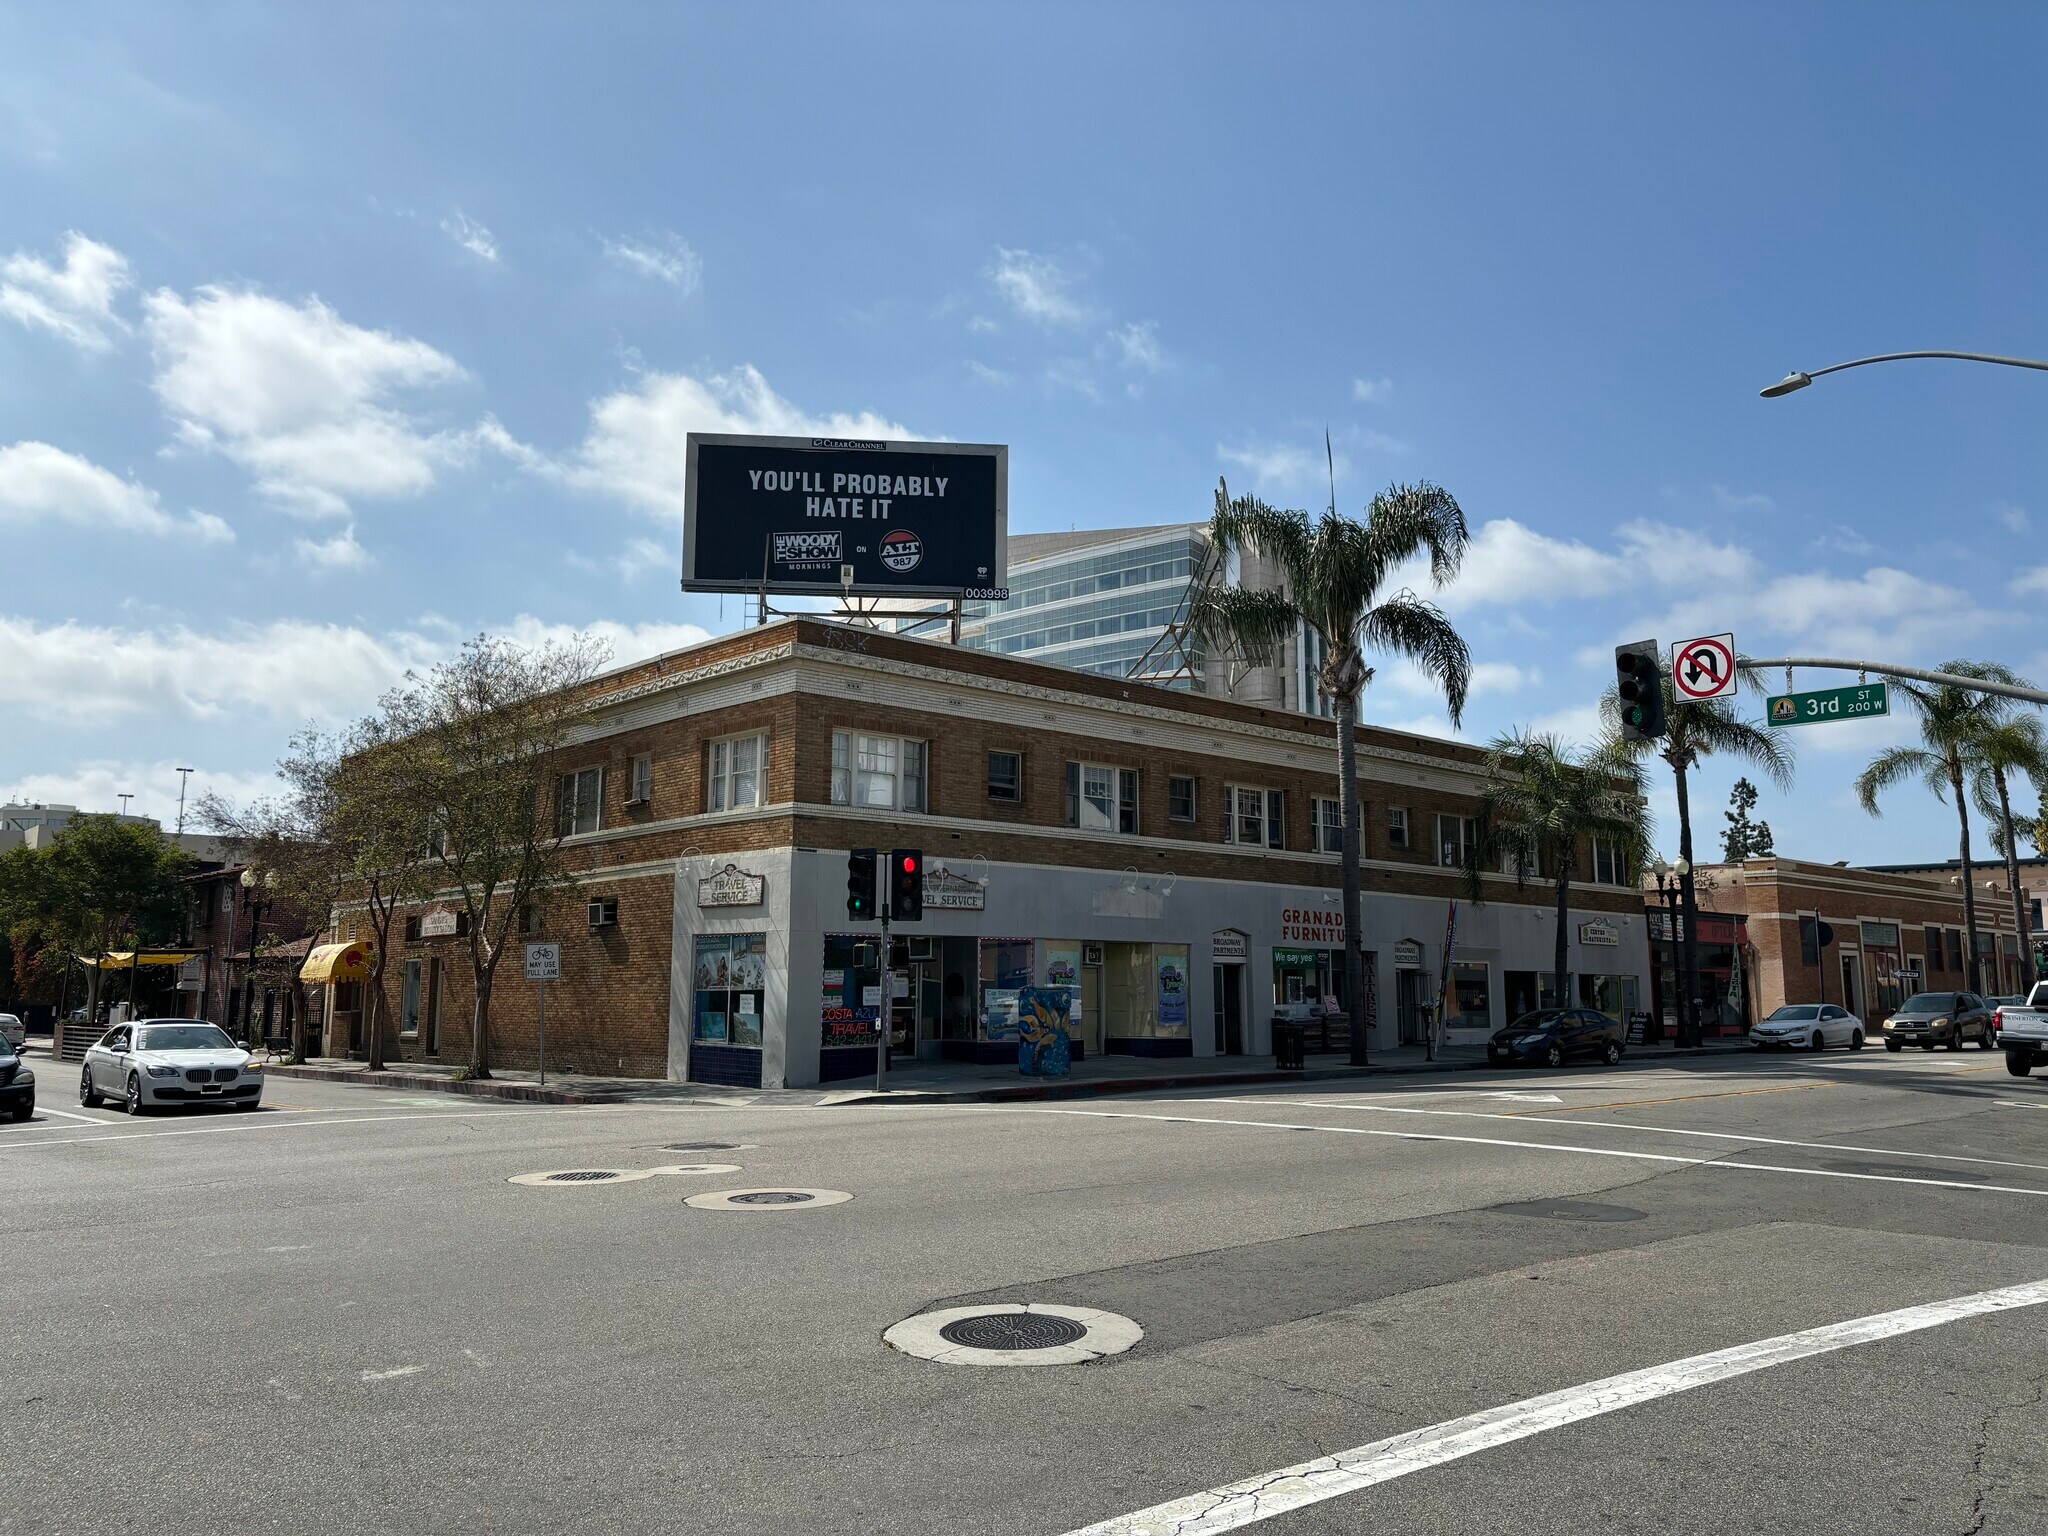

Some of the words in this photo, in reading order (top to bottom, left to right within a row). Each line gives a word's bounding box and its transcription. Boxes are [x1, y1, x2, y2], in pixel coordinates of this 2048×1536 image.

[749, 470, 825, 493] YOU'LL
[833, 474, 948, 497] PROBABLY
[806, 496, 864, 519] HATE
[872, 499, 892, 519] IT
[786, 534, 839, 547] WOODY
[776, 536, 786, 560] THE
[786, 546, 838, 560] SHOW
[881, 542, 918, 556] ALT
[892, 557, 912, 567] 98.7
[966, 588, 1008, 600] 003998
[1858, 690, 1870, 700] ST
[1806, 696, 1839, 716] 3rd
[1848, 702, 1870, 712] 200
[1874, 700, 1882, 710] W
[714, 879, 747, 890] TRAVEL
[712, 891, 748, 904] SERVICE
[922, 894, 937, 904] VEL
[941, 895, 978, 906] SERVICE
[1282, 908, 1343, 926] GRANAD
[1282, 926, 1345, 942] FURNITU
[1274, 952, 1285, 962] We
[1287, 954, 1300, 964] say
[1301, 954, 1313, 964] yes
[1365, 955, 1376, 1029] MATTRESS
[822, 1008, 853, 1020] COSTA
[830, 1023, 871, 1035] TRAVEL
